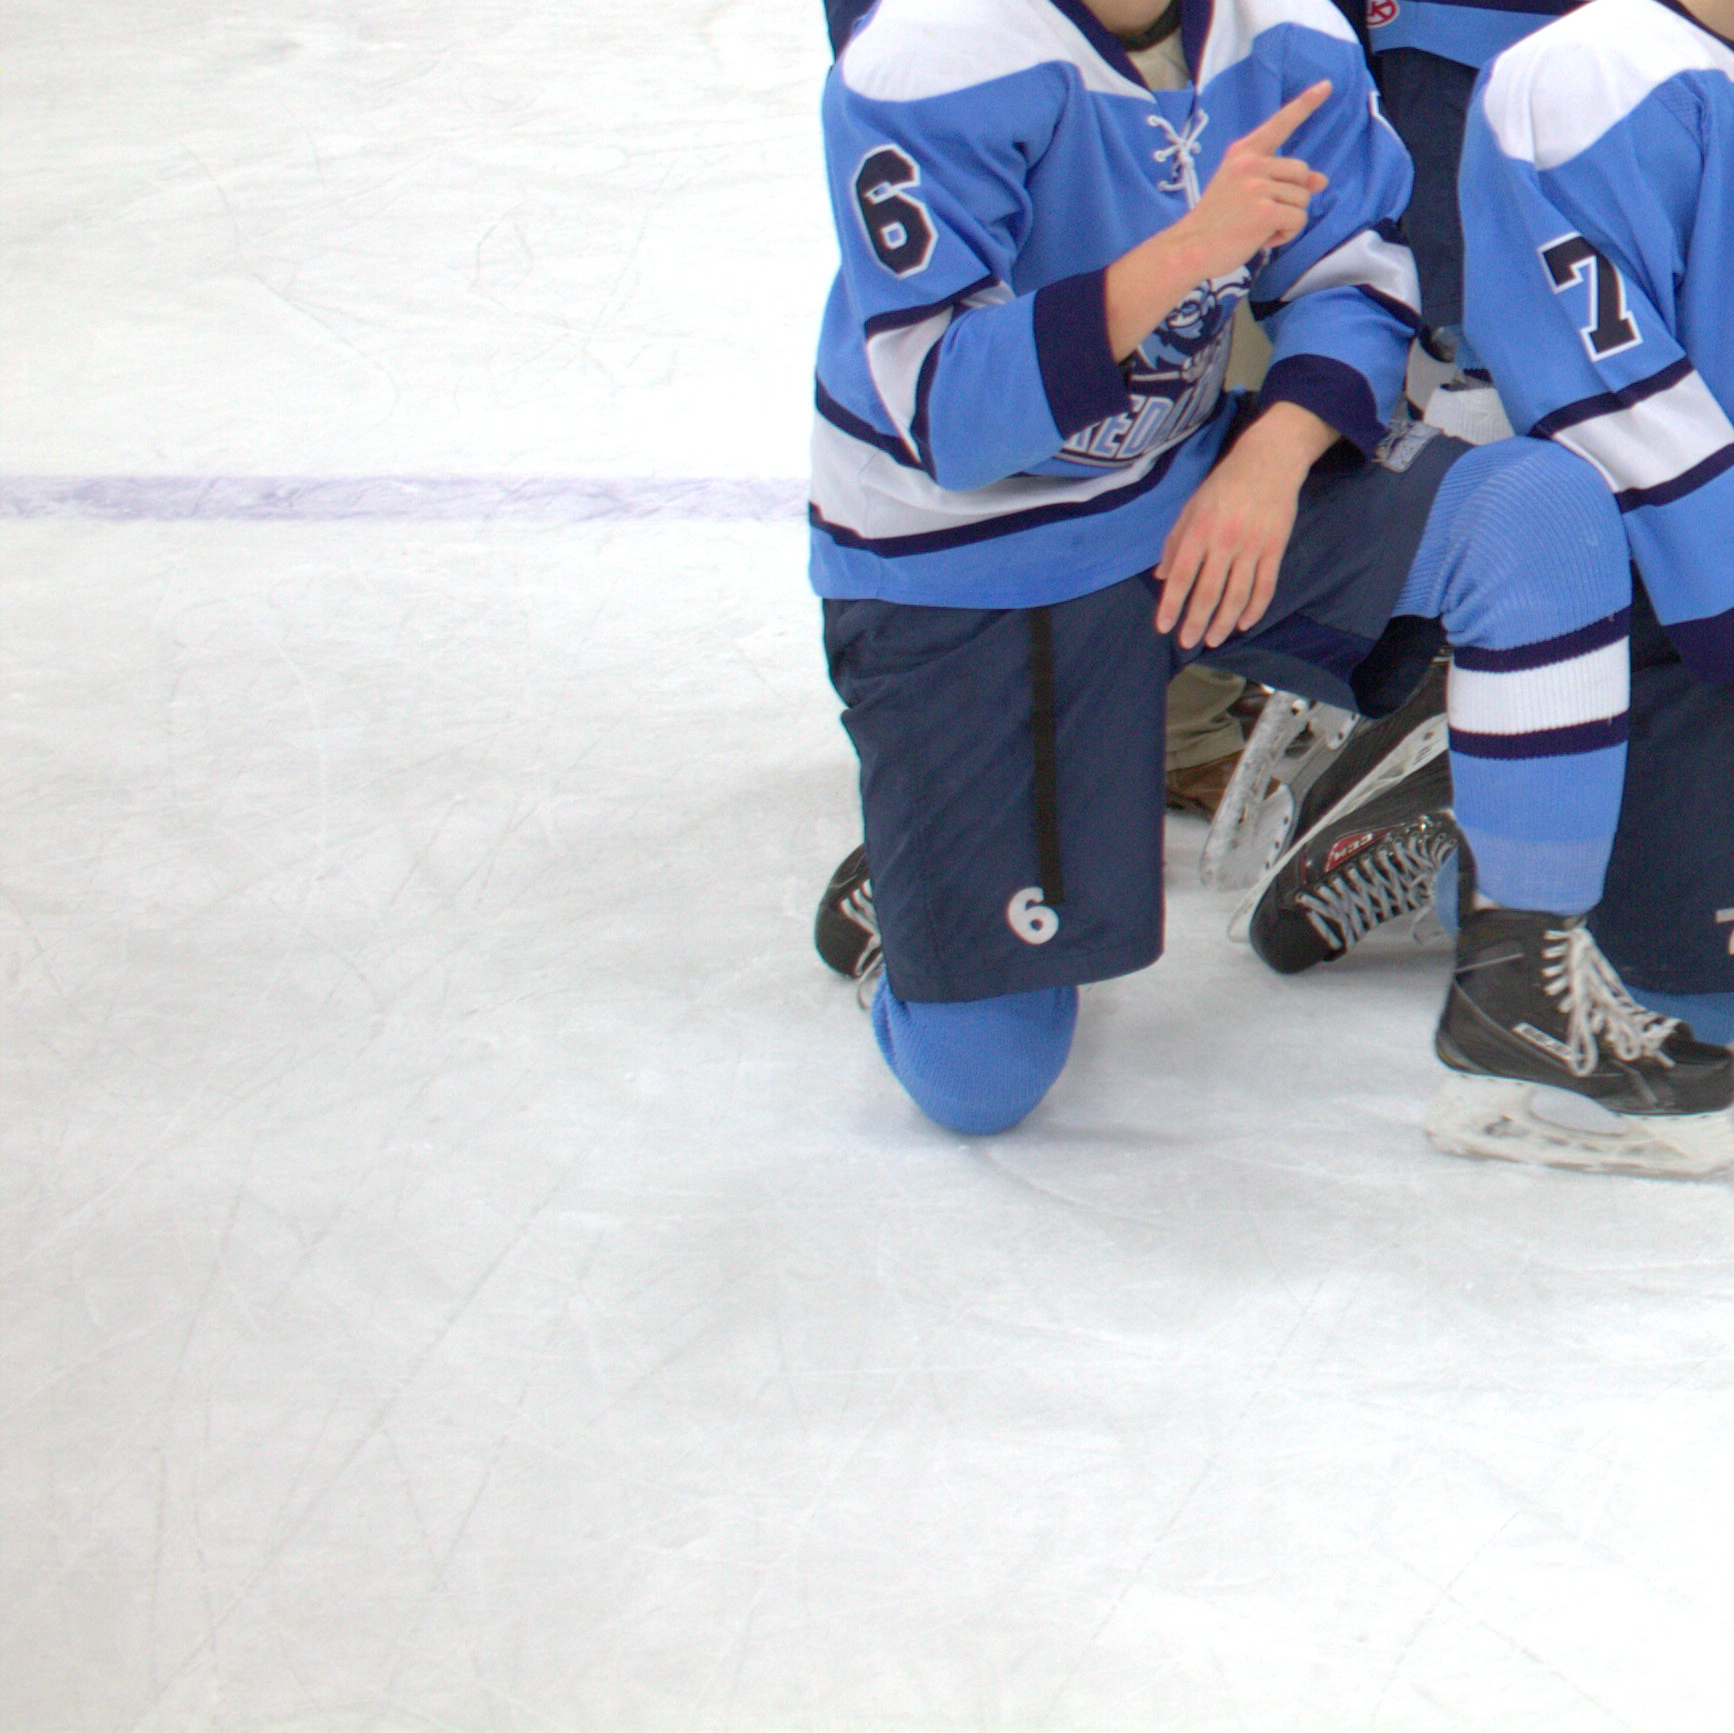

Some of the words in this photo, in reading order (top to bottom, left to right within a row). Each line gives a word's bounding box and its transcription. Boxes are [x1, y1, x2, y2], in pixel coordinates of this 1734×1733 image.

[854, 144, 939, 280] 6
[1537, 231, 1645, 363] 7
[1006, 884, 1059, 945] 6
